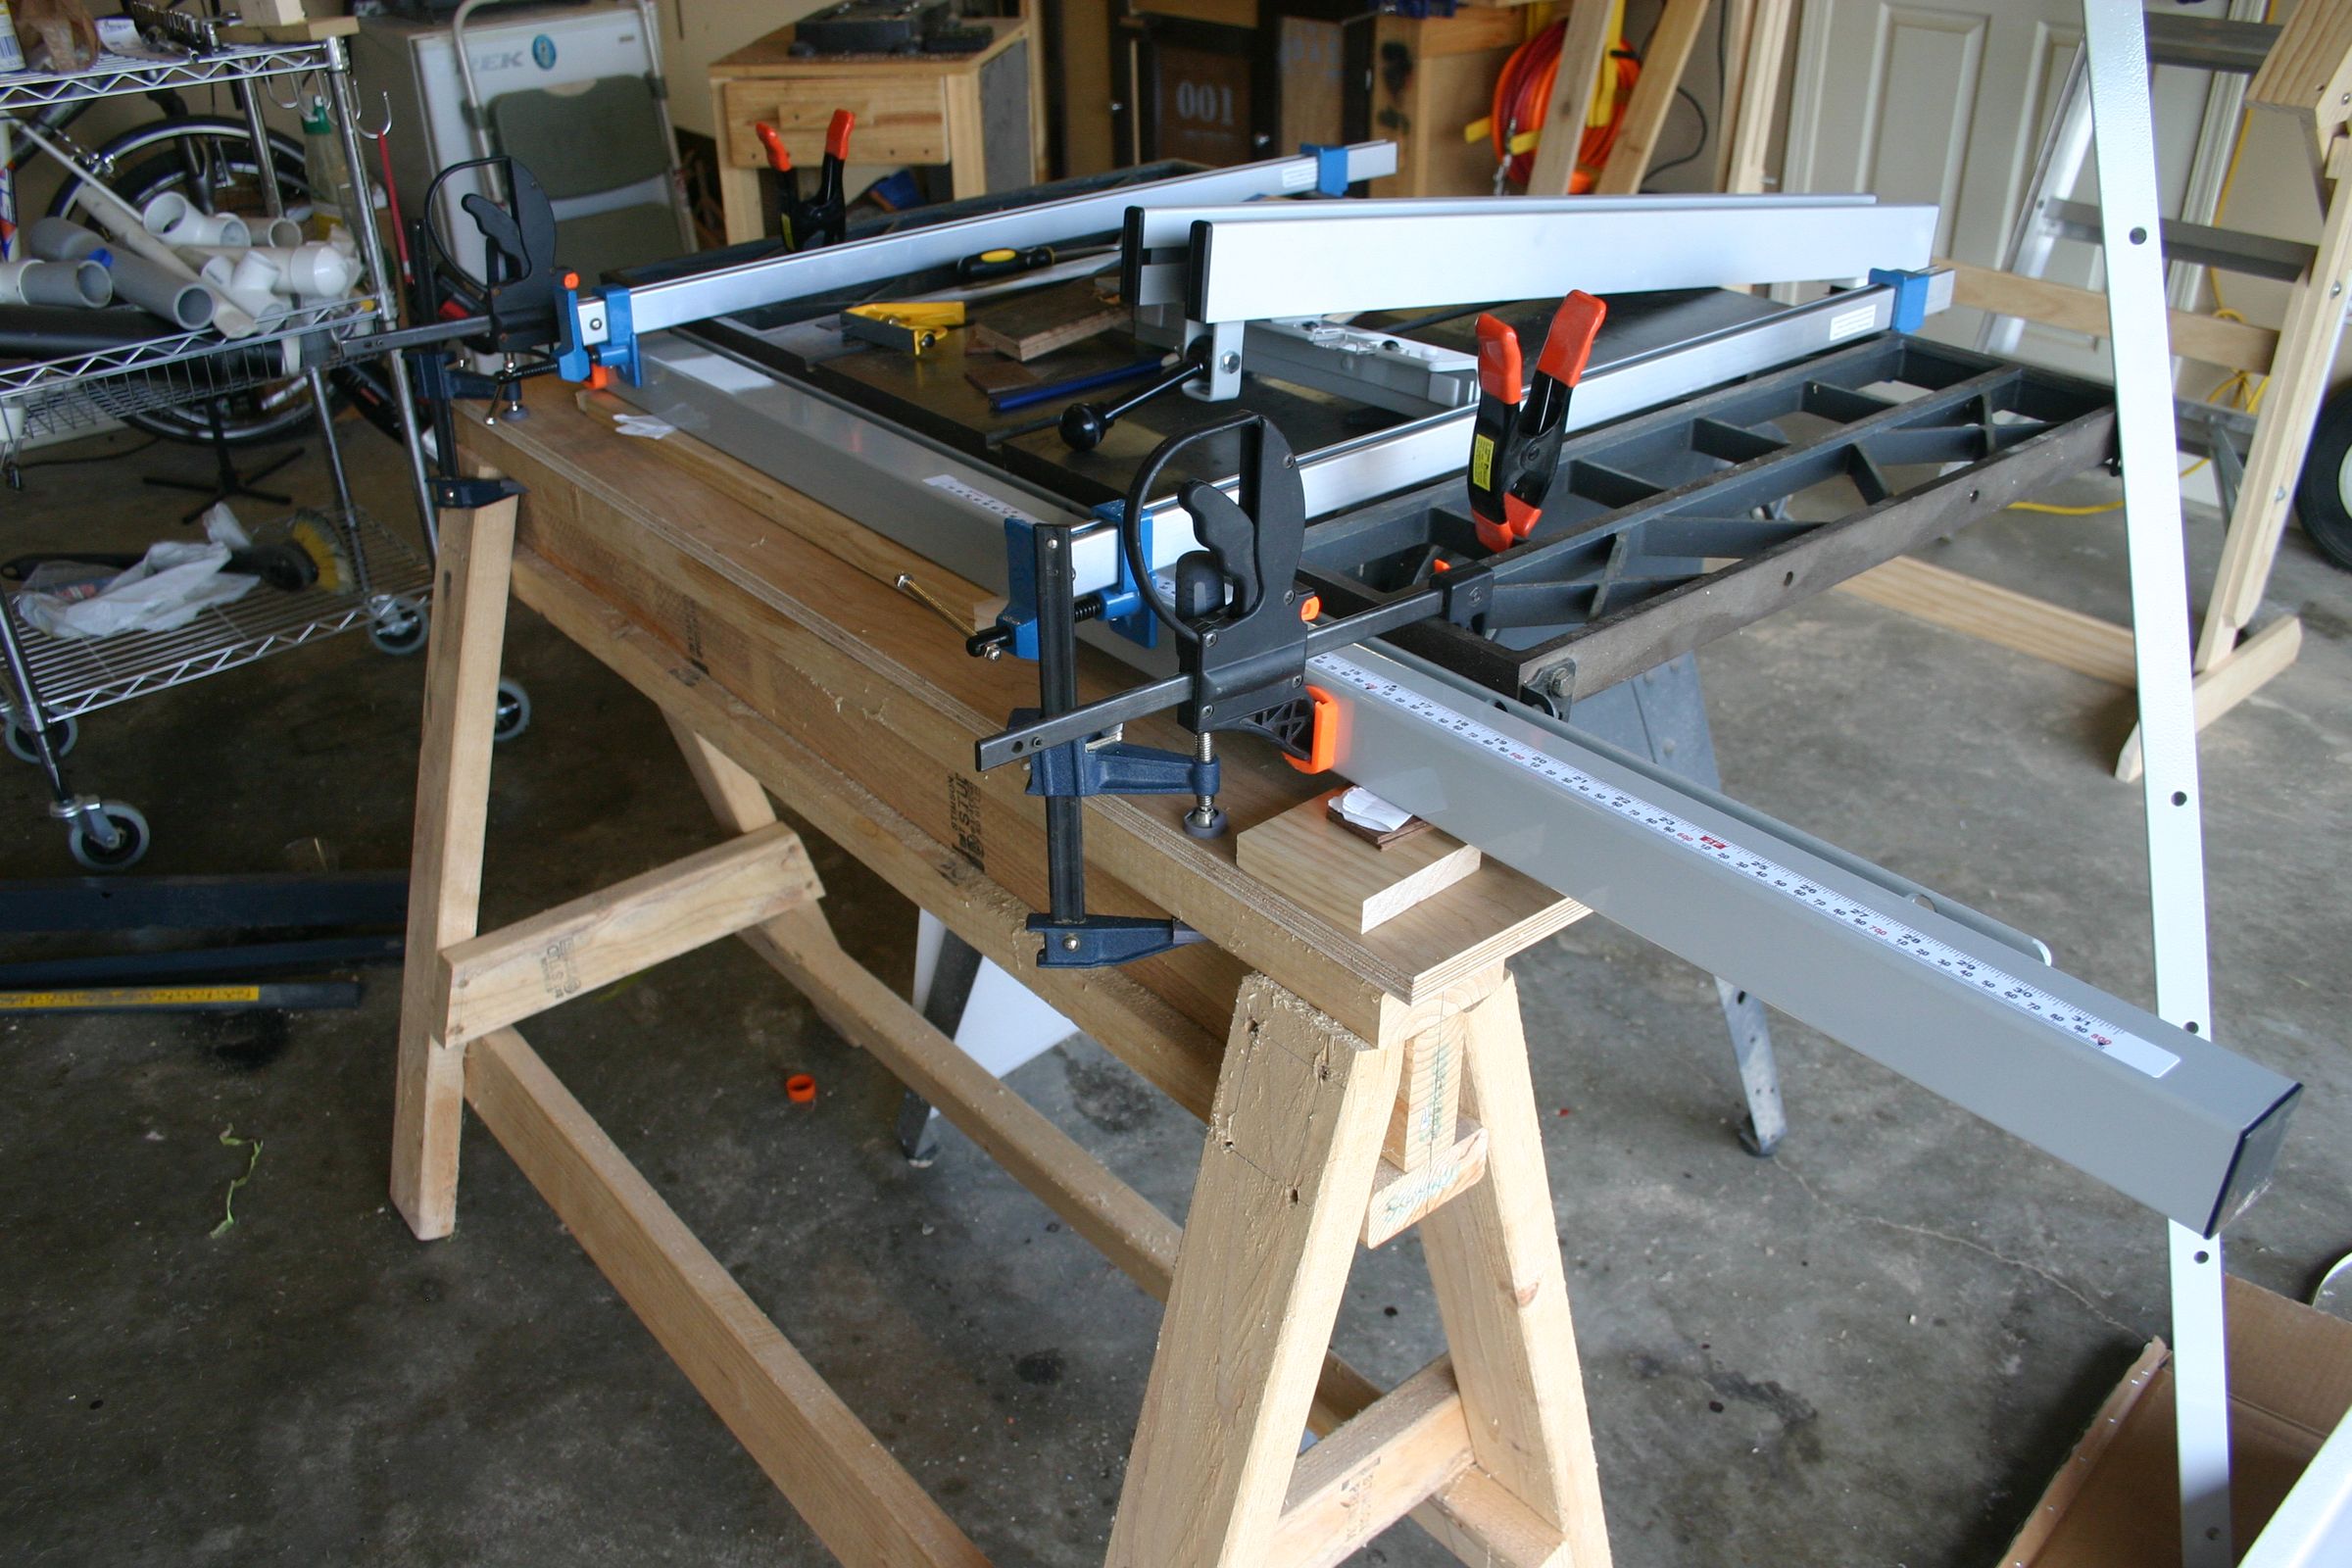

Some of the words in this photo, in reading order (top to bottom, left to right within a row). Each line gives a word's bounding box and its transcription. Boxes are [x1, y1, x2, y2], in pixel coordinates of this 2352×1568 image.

[1177, 79, 1234, 126] 001
[1532, 756, 1547, 764] 20
[1573, 775, 1588, 784] 21
[1615, 796, 1631, 804] 22
[1659, 816, 1675, 825] 23
[1751, 861, 1768, 870] 25
[1799, 884, 1817, 894] 26
[1850, 908, 1869, 917] 27
[1956, 960, 1976, 970] 29
[2013, 986, 2033, 998] 30
[2072, 1015, 2091, 1026] 31
[1677, 833, 1694, 842] 600
[1853, 918, 1867, 926] 90
[1869, 925, 1888, 936] 700
[1916, 948, 1930, 956] 20
[1937, 958, 1952, 967] 30
[1982, 980, 1996, 988] 50
[2004, 991, 2018, 999] 60
[2027, 1002, 2041, 1010] 70
[2050, 1013, 2064, 1022] 80
[2073, 1025, 2088, 1033] 90
[2091, 1033, 2112, 1045] 800
